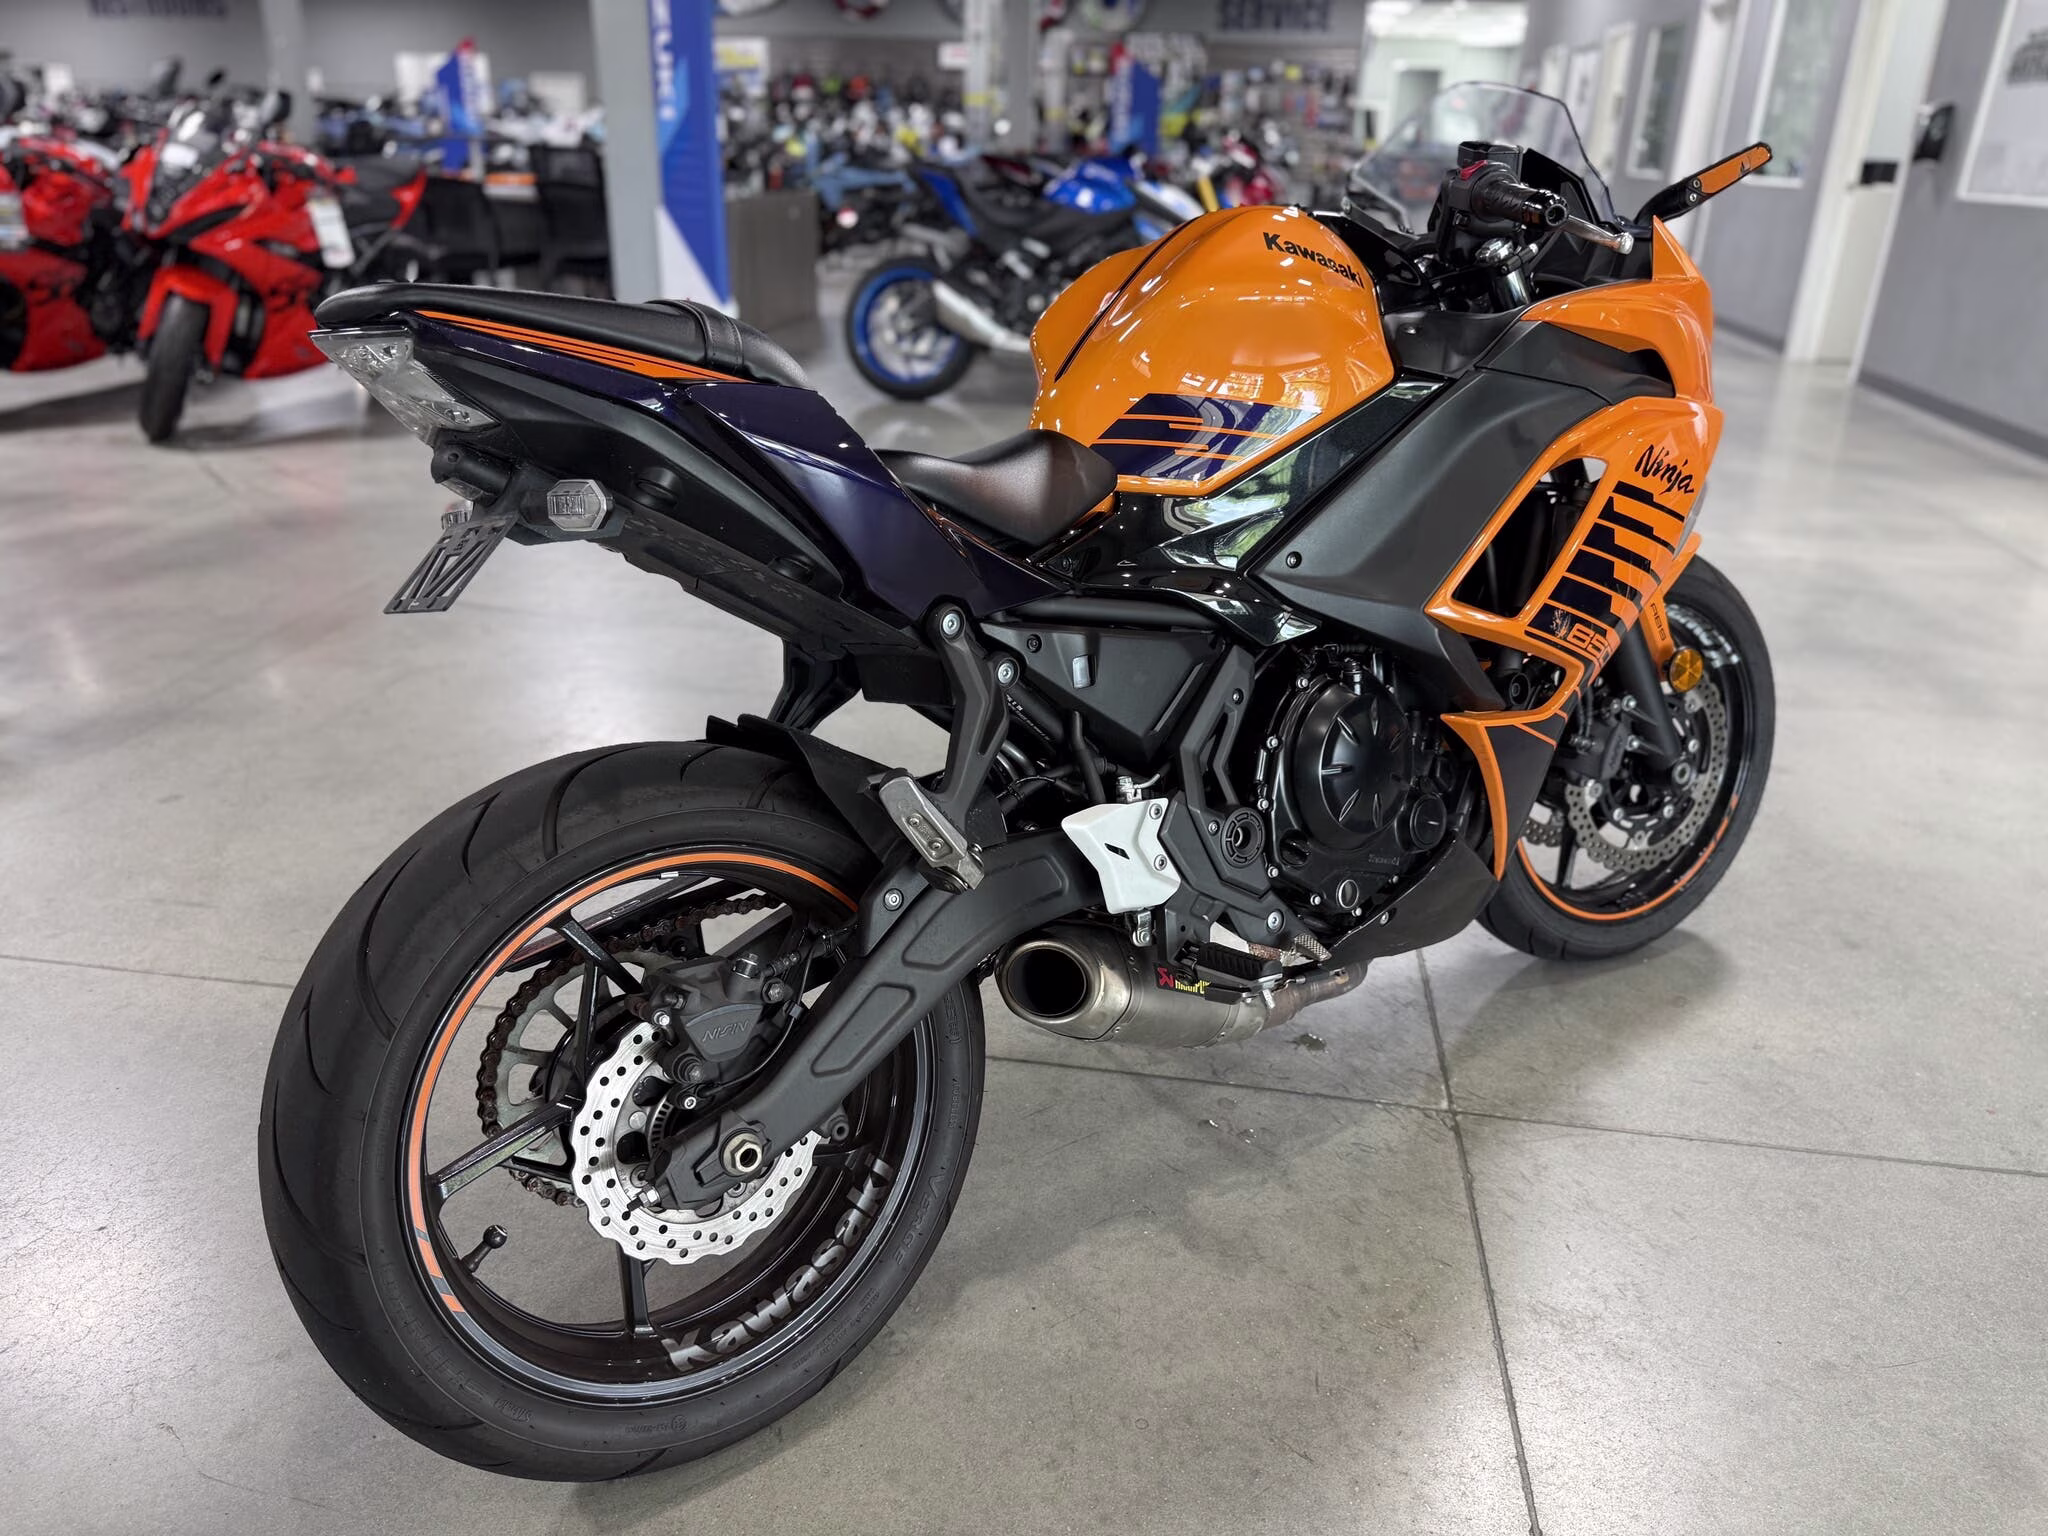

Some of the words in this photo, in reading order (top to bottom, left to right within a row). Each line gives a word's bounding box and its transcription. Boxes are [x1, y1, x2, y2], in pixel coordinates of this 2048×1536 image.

[1263, 231, 1365, 289] Kawasaki
[1634, 444, 1695, 496] Ninja
[1650, 602, 1667, 641] ABS
[660, 1152, 894, 1372] Kawasaki
